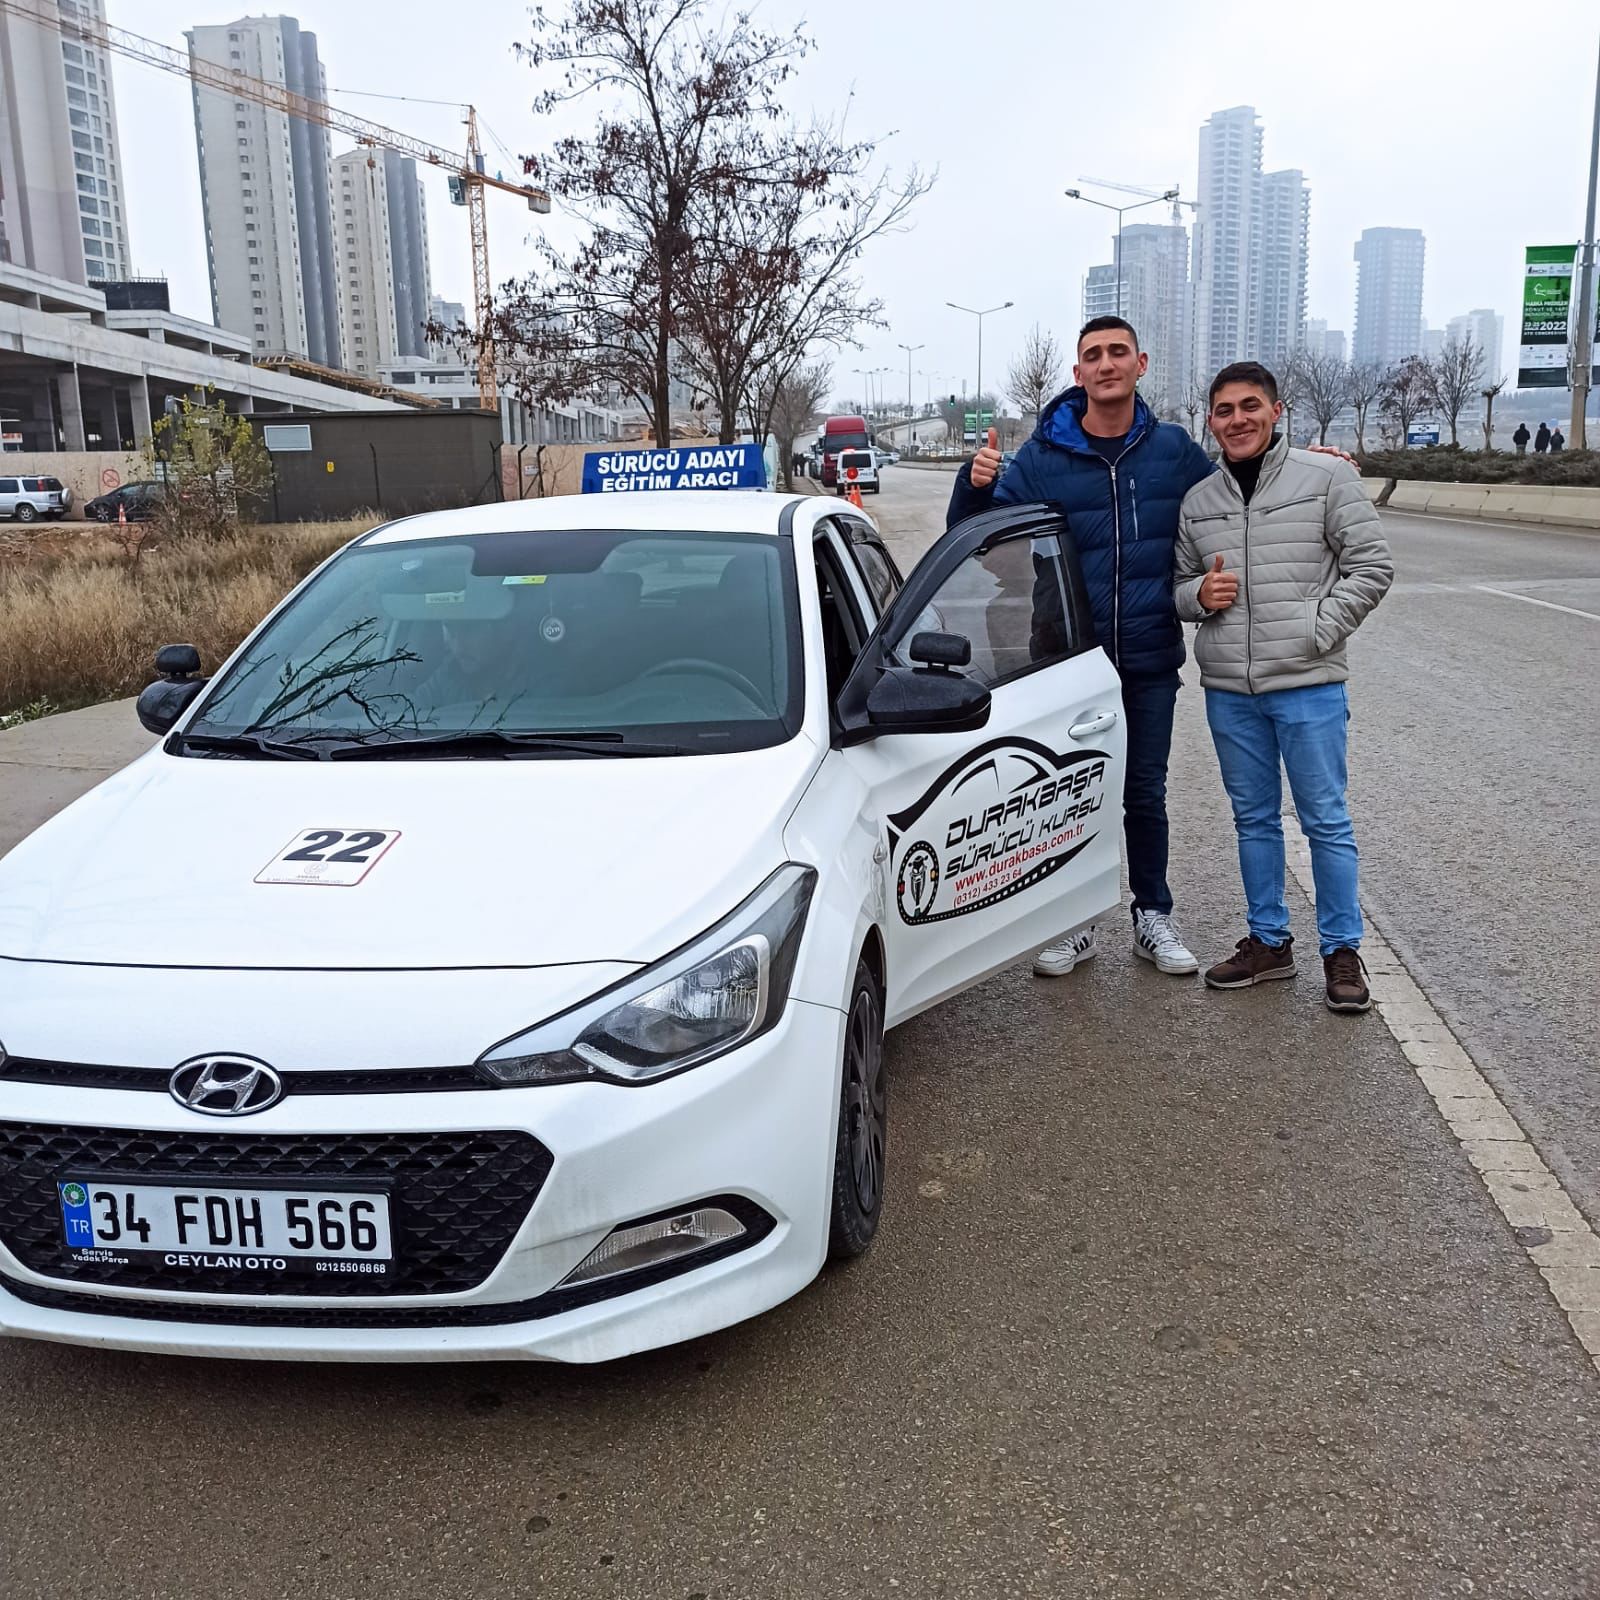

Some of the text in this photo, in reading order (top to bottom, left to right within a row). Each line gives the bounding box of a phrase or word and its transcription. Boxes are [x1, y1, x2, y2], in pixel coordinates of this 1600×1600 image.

[1540, 321, 1566, 330] 2022
[598, 449, 745, 474] SÜRÜCÜ ADAYI
[602, 471, 738, 492] EĞİTİM ARACI
[945, 760, 1105, 849] DURAKBAŞA
[282, 830, 387, 863] 22
[944, 792, 1105, 880] SÜRÜCÜ KURSU
[955, 823, 1085, 892] www.durakbasa.com.tr
[953, 887, 981, 909] (0312)
[982, 878, 998, 893] 433
[1000, 873, 1010, 886] 23
[70, 1191, 377, 1251] TR 34 FDH 566
[81, 1248, 113, 1257] Servis
[164, 1254, 286, 1270] CEYLAN OTO
